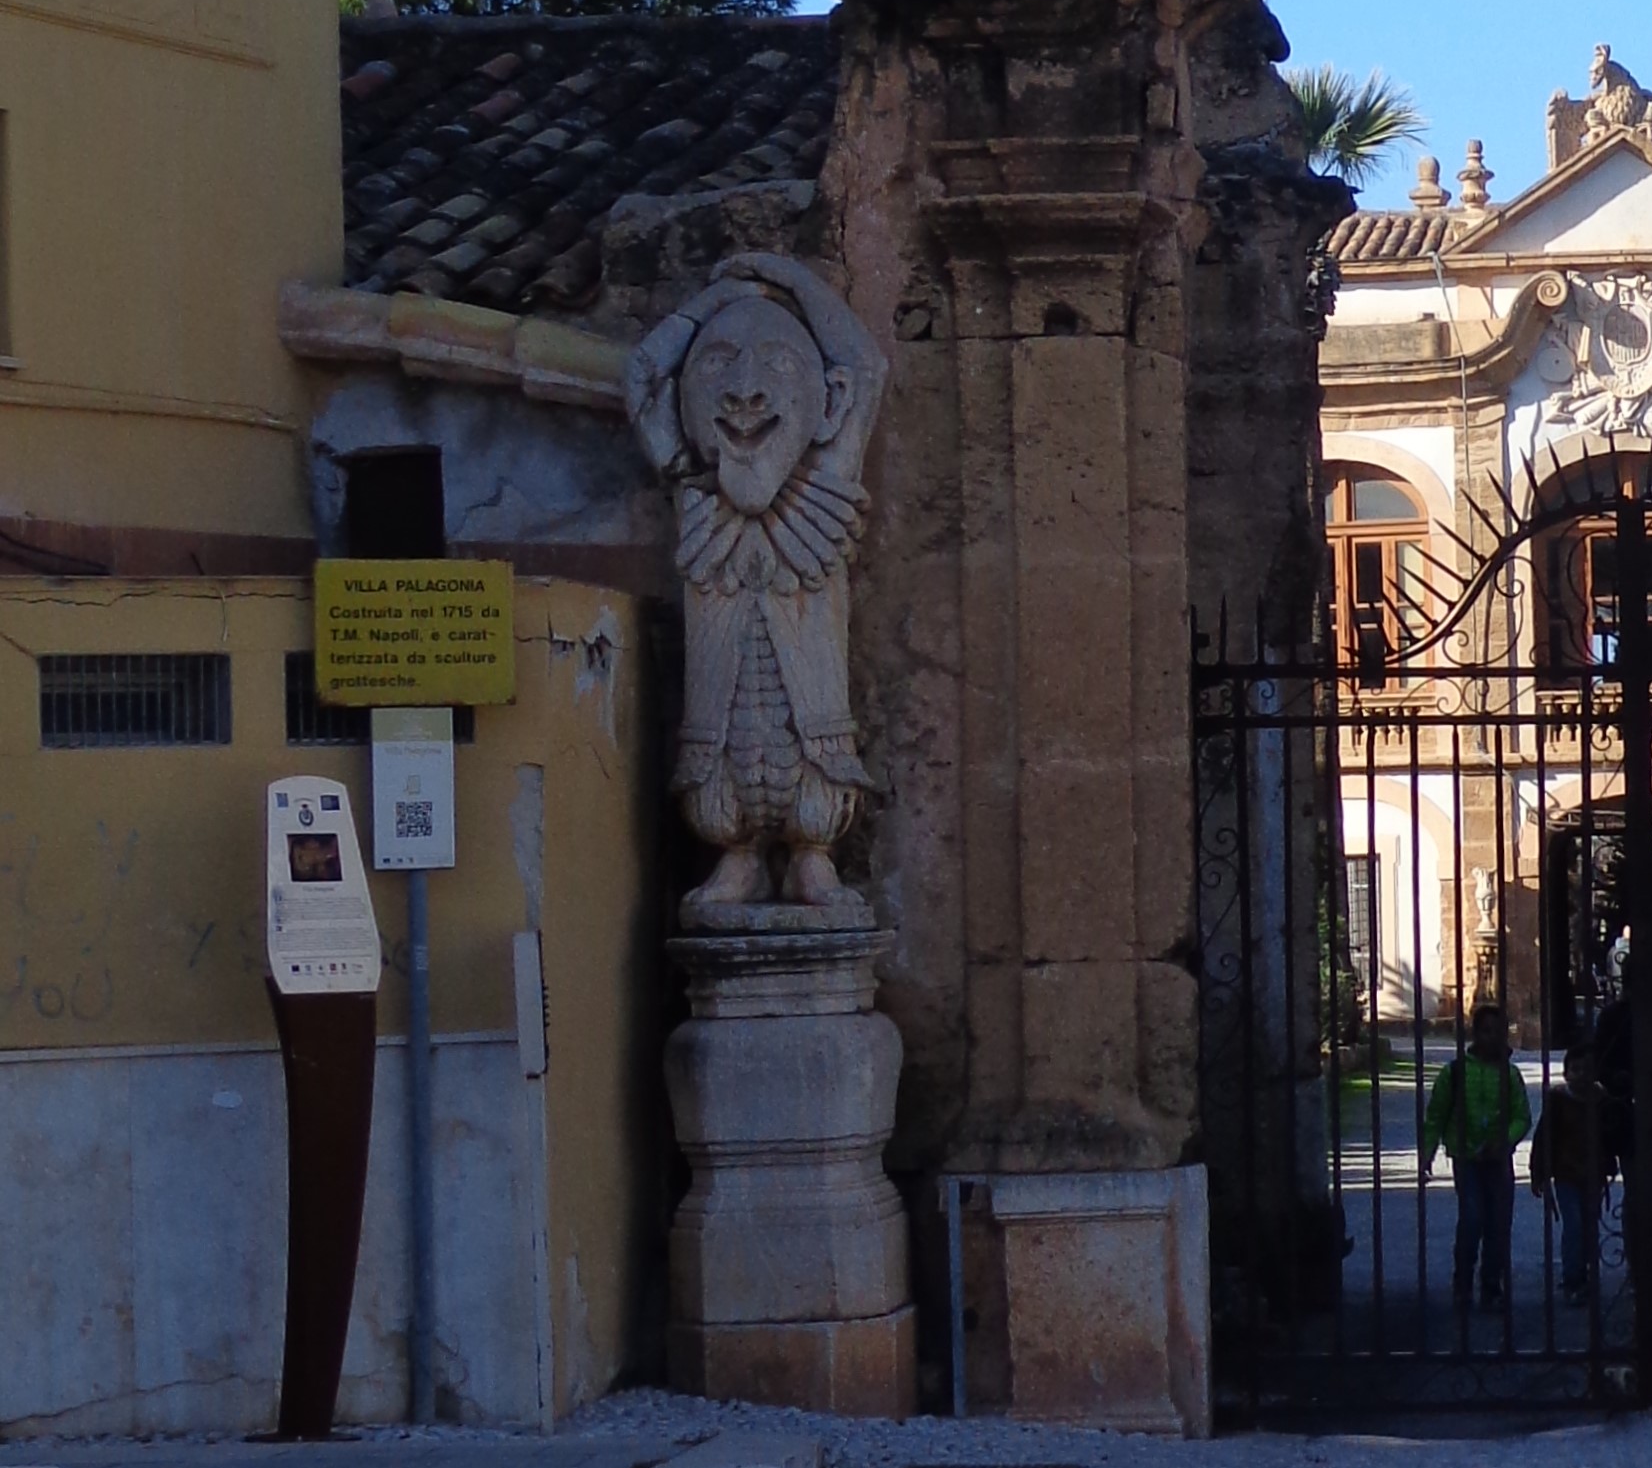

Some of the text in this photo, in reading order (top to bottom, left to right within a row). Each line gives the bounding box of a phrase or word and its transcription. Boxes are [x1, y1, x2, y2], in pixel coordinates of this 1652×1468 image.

[343, 578, 486, 593] VILLA PALAGONIA
[329, 605, 500, 620] Costruita nel 1715 da
[369, 628, 424, 644] Napoli,
[330, 651, 497, 665] terizzata da sculture
[329, 675, 422, 691] grottesche.
